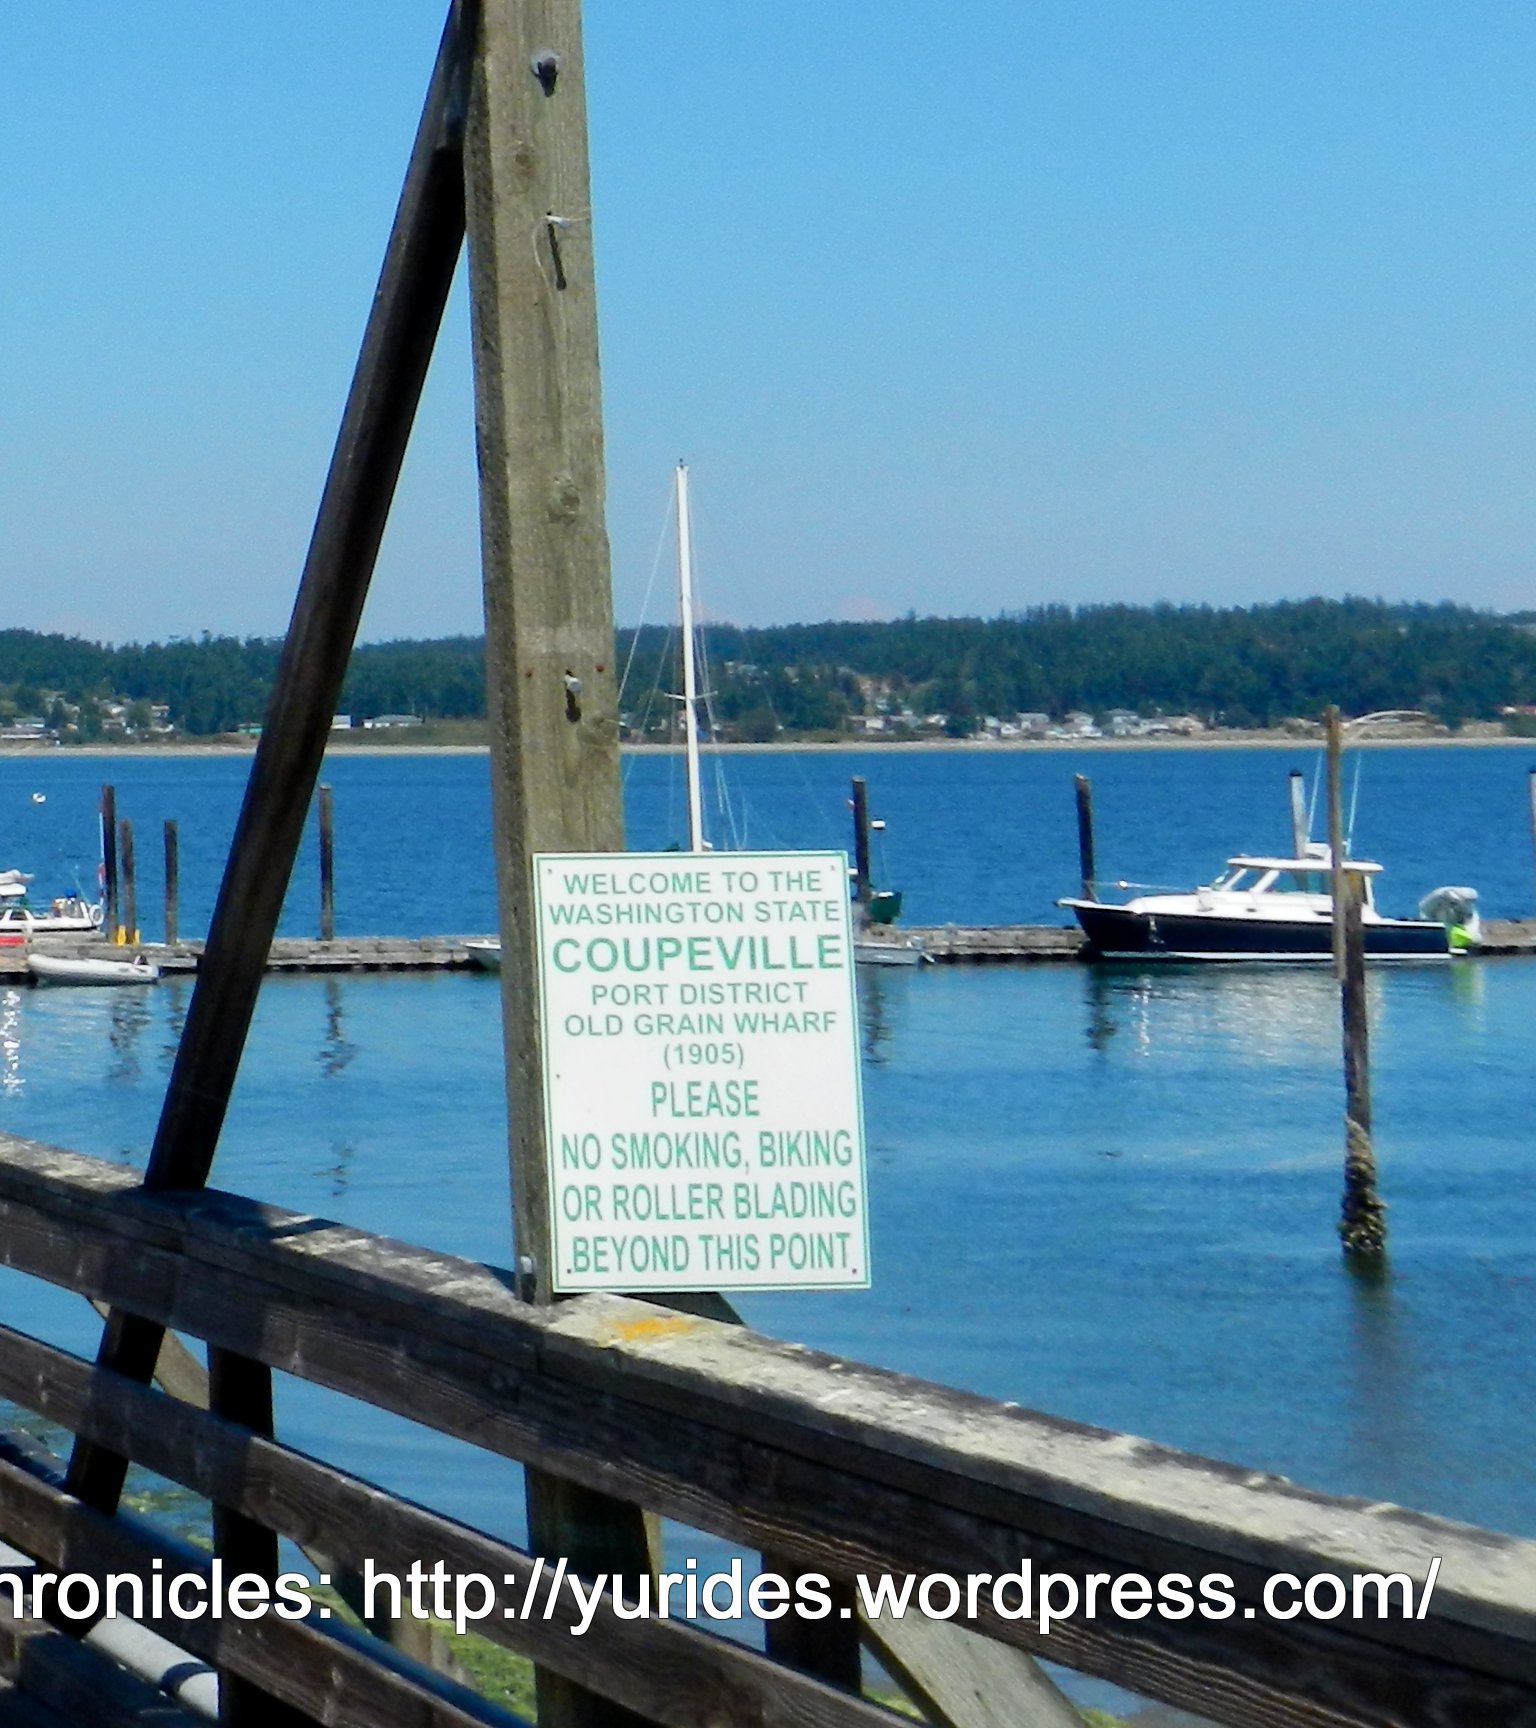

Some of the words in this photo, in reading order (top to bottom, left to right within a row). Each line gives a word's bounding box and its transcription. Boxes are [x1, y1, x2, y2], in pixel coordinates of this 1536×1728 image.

[563, 871, 712, 896] WELCOME
[726, 871, 759, 894] TO
[768, 870, 823, 893] THE
[549, 900, 745, 926] WASHINGTON
[754, 899, 841, 922] STATE
[552, 933, 845, 973] COUPEVILLE
[591, 983, 669, 1006] PORT
[680, 981, 809, 1005] DISTRICT
[564, 1013, 624, 1037] OLD
[634, 1012, 725, 1036] GRAIN
[734, 1010, 837, 1034] WHARF
[663, 1042, 746, 1071] (1905)
[651, 1079, 760, 1119] PLEASE
[561, 1131, 602, 1170] NO
[611, 1130, 751, 1175] SMOKING,
[758, 1128, 853, 1168] BIKING
[563, 1183, 603, 1222] OR
[613, 1182, 726, 1221] ROLLER
[734, 1179, 857, 1220] BLADING
[571, 1234, 690, 1274] BEYOND
[698, 1232, 761, 1271] THIS
[769, 1230, 851, 1271] POINT
